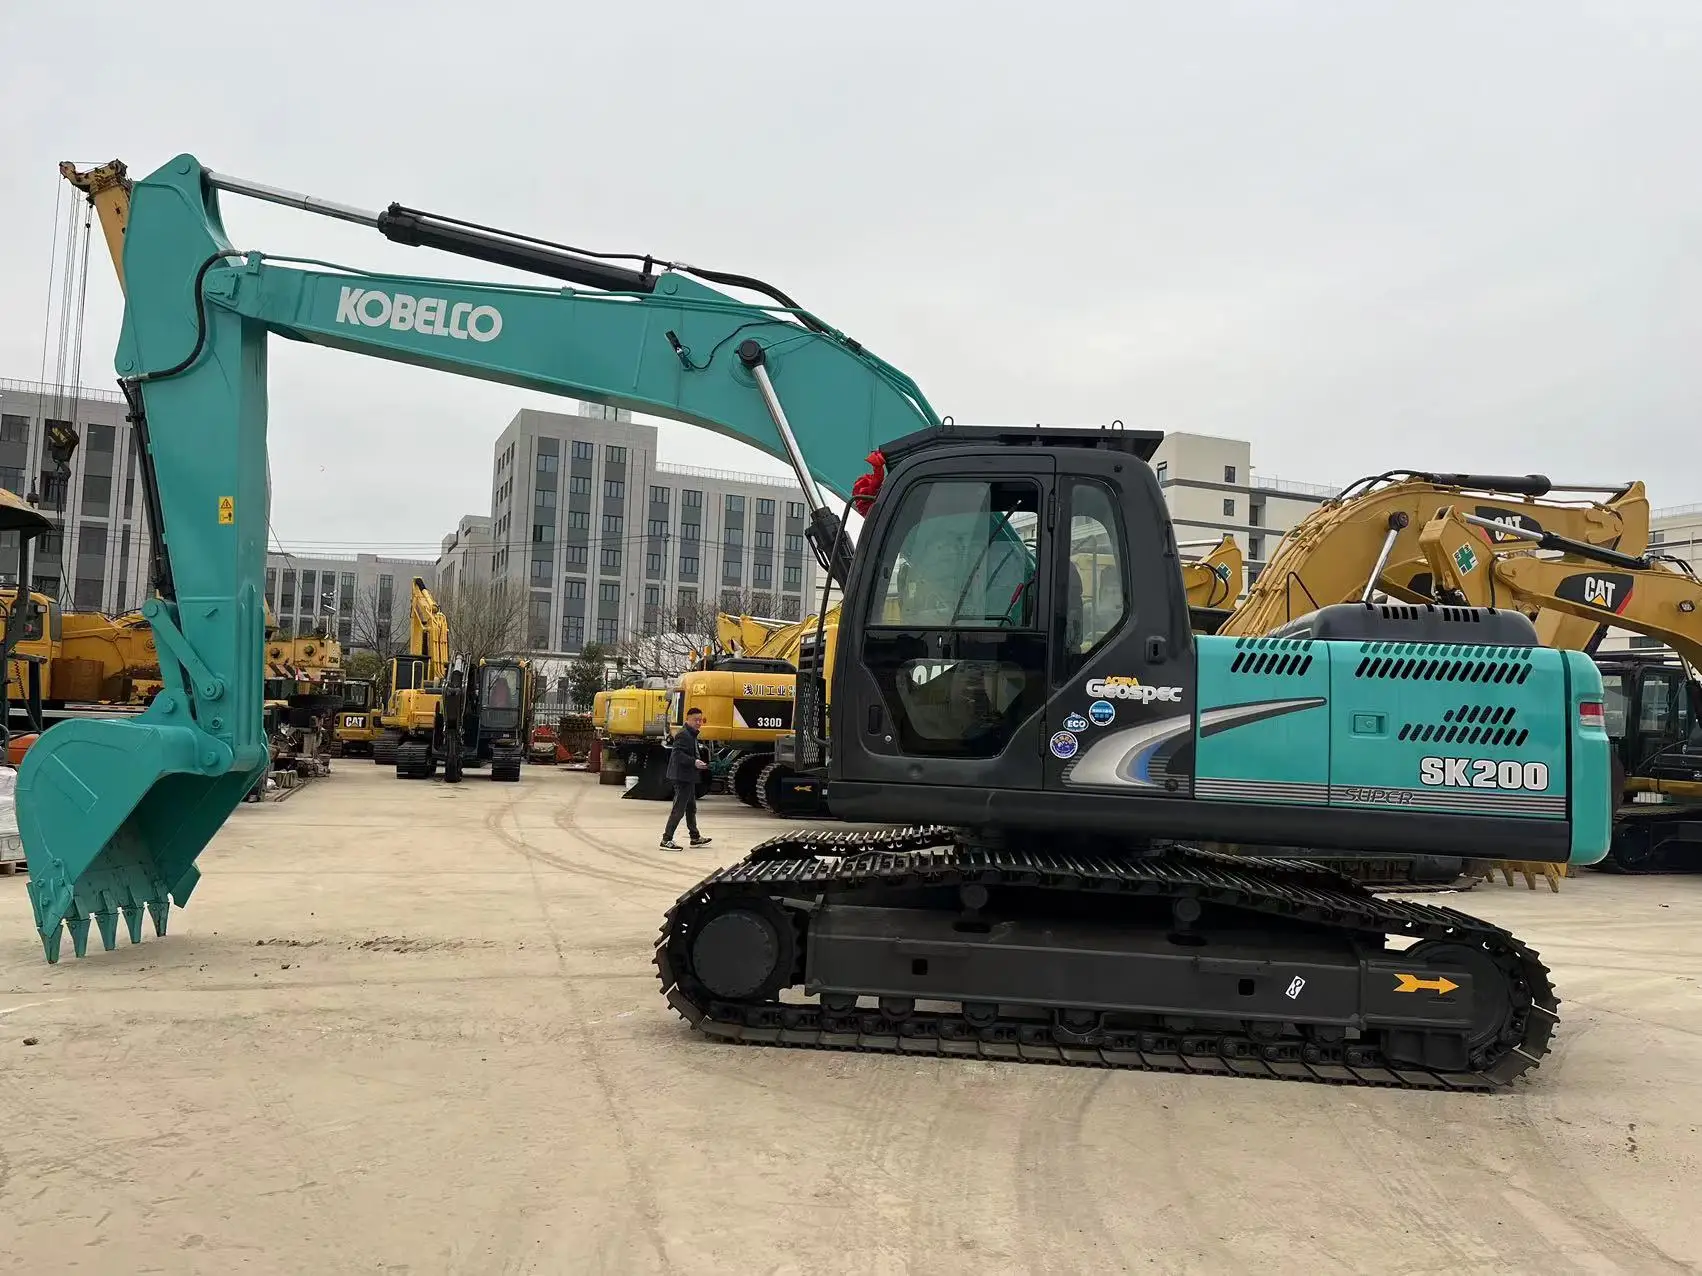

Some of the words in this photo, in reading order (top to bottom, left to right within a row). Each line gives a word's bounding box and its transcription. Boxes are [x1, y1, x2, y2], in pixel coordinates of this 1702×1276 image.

[336, 286, 503, 342] KOBELCO
[1584, 576, 1616, 608] CAT
[743, 684, 786, 695] 浅川工业
[345, 716, 364, 728] CAT
[757, 717, 782, 727] 330D
[1067, 720, 1086, 728] ECO
[1420, 757, 1549, 791] SK200
[1345, 788, 1414, 805] SUPER
